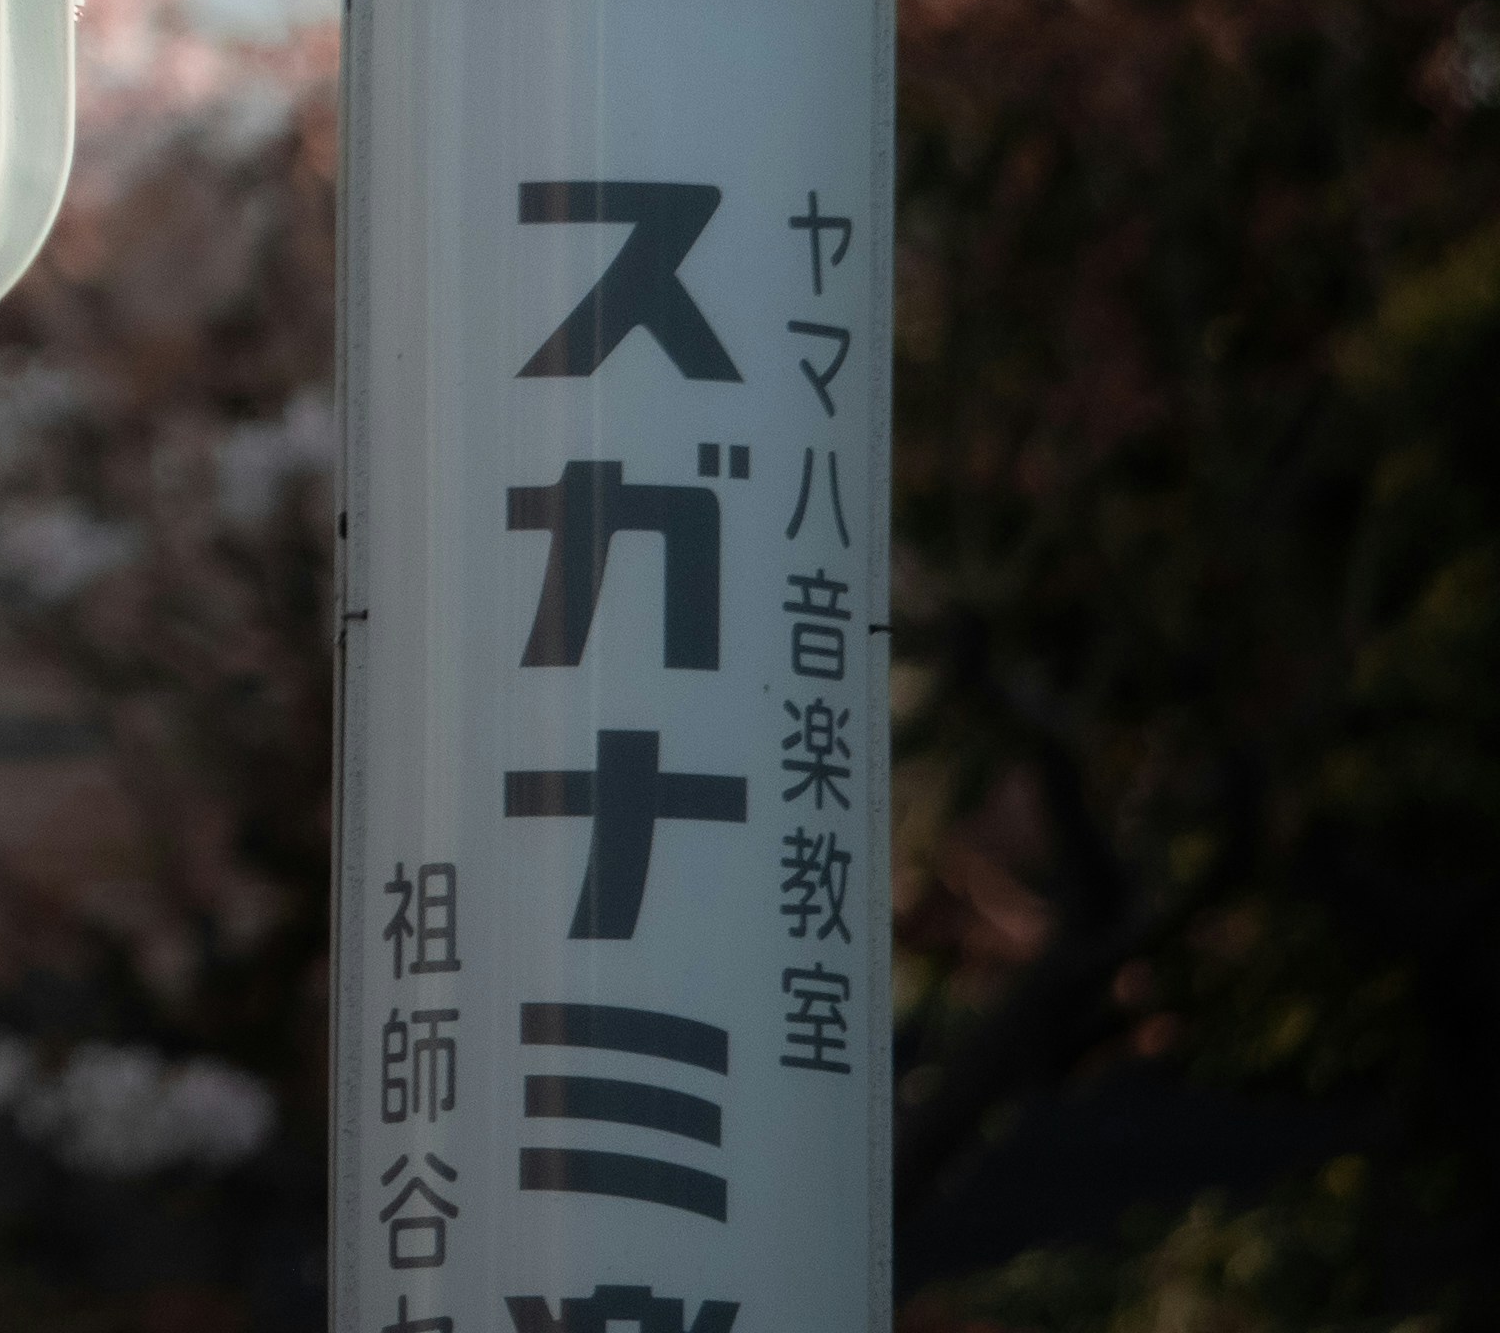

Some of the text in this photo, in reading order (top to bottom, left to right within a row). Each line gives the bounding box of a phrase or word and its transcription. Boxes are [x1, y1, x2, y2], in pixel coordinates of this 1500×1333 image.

[503, 180, 750, 1333] スガナミ
[779, 189, 853, 1075] ヤマハ音楽教室
